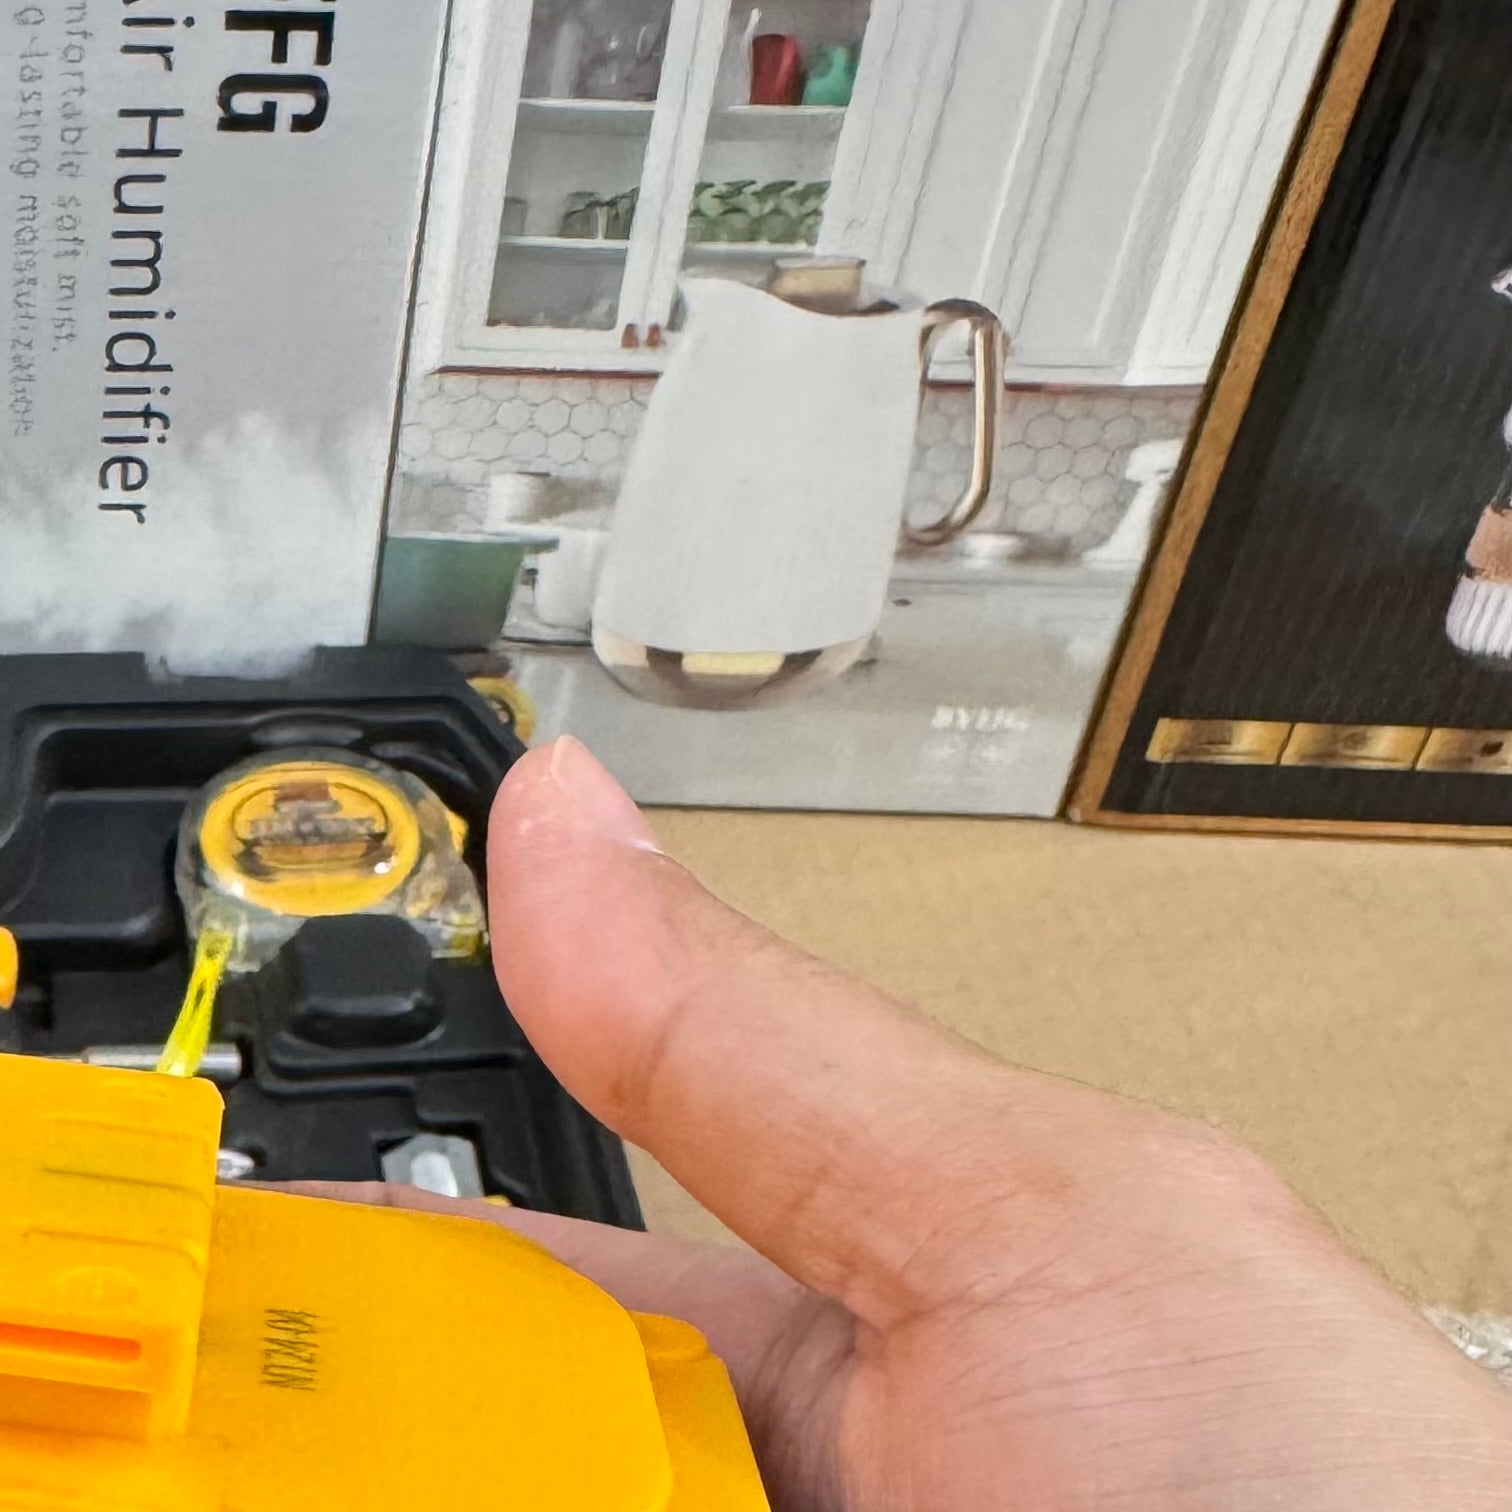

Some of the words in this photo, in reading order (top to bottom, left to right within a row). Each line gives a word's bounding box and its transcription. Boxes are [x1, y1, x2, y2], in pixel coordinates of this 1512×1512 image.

[118, 0, 196, 71] ir
[215, 0, 337, 133] FG
[98, 107, 185, 525] Humidifier
